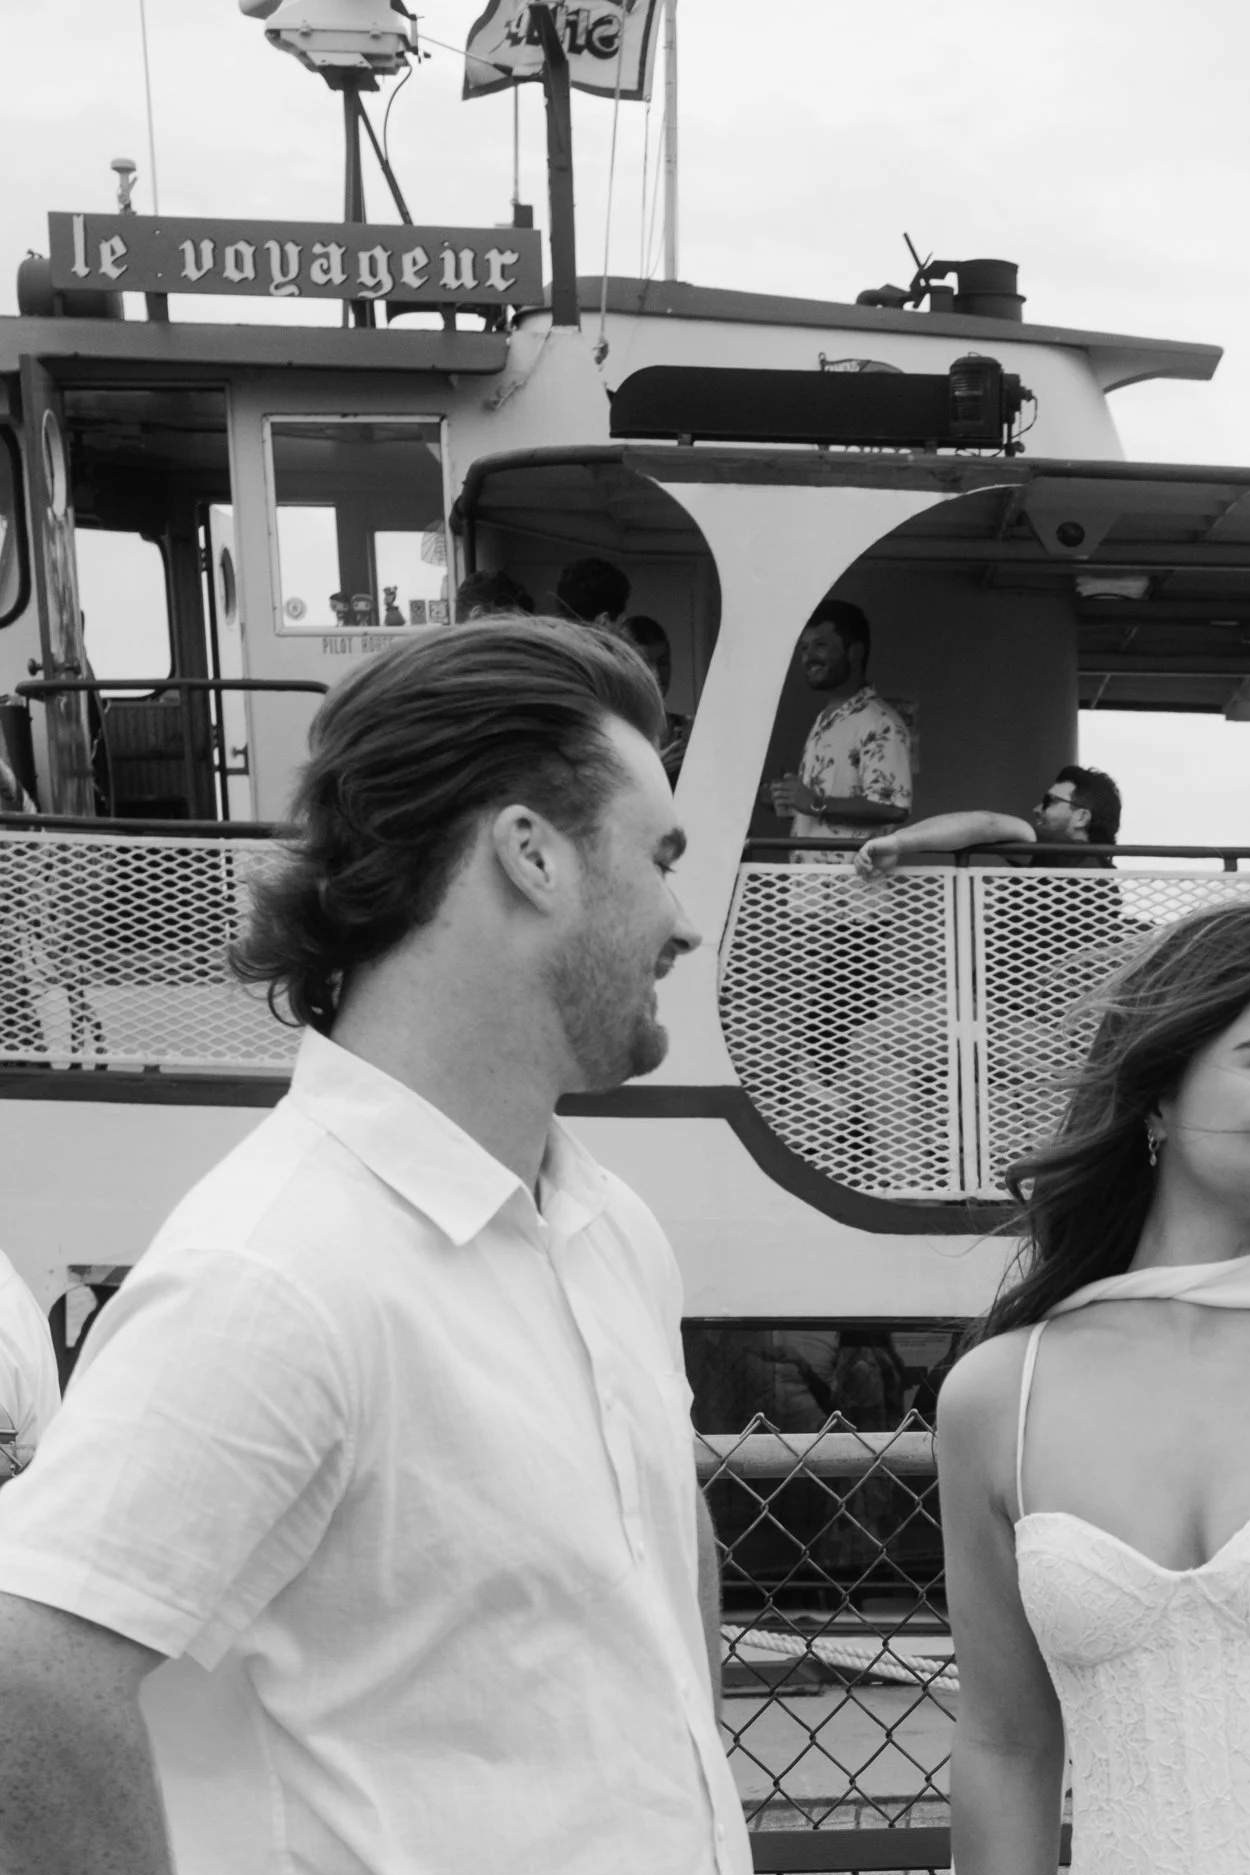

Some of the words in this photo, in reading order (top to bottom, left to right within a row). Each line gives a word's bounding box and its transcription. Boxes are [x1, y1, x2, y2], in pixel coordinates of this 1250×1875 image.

[71, 214, 128, 279] le
[179, 238, 519, 298] voyageur
[322, 636, 353, 654] PILOT
